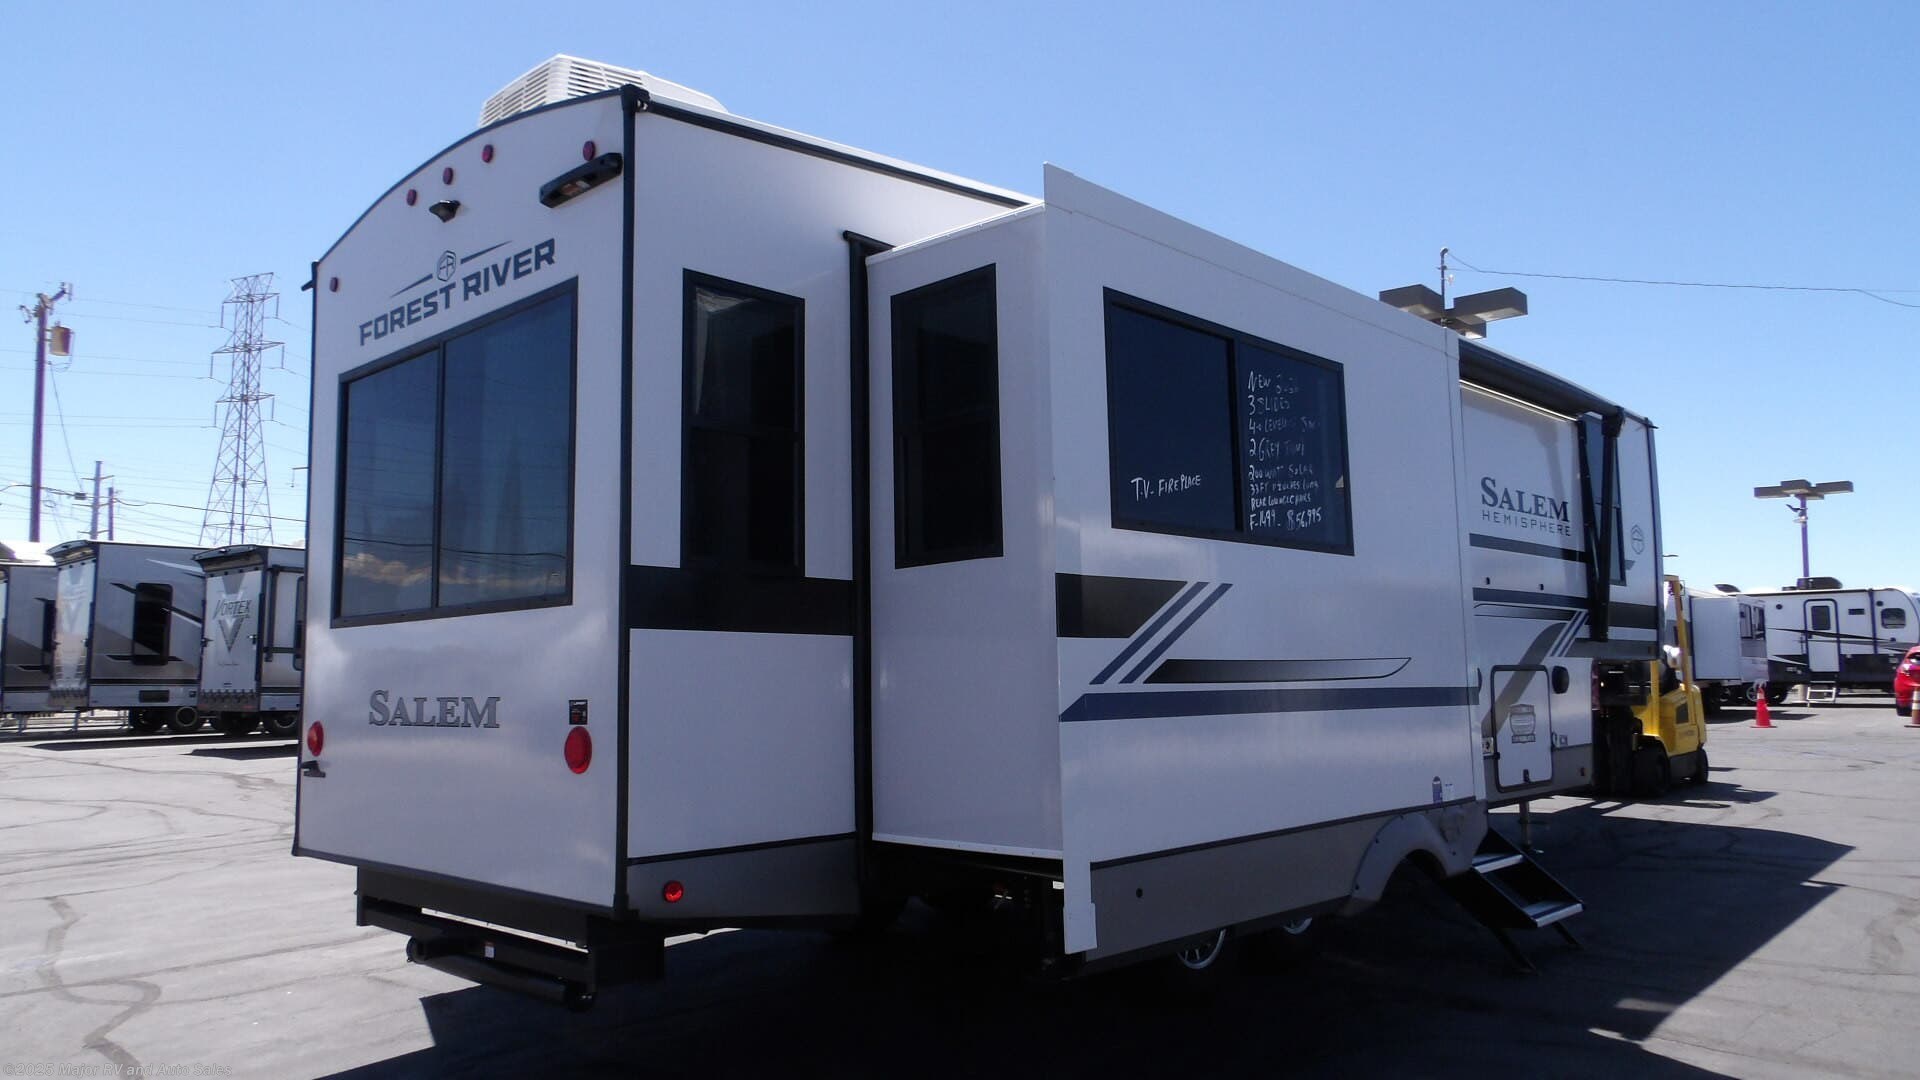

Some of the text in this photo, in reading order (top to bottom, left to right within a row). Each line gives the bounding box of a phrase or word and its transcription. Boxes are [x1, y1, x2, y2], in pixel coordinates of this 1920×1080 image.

[360, 237, 555, 346] FOREST RIVER
[1247, 370, 1272, 392] NEW
[1480, 476, 1570, 522] SALEM
[1481, 509, 1572, 536] HEMISPHERE
[213, 599, 252, 620] VORTEX
[368, 689, 500, 728] SALEM
